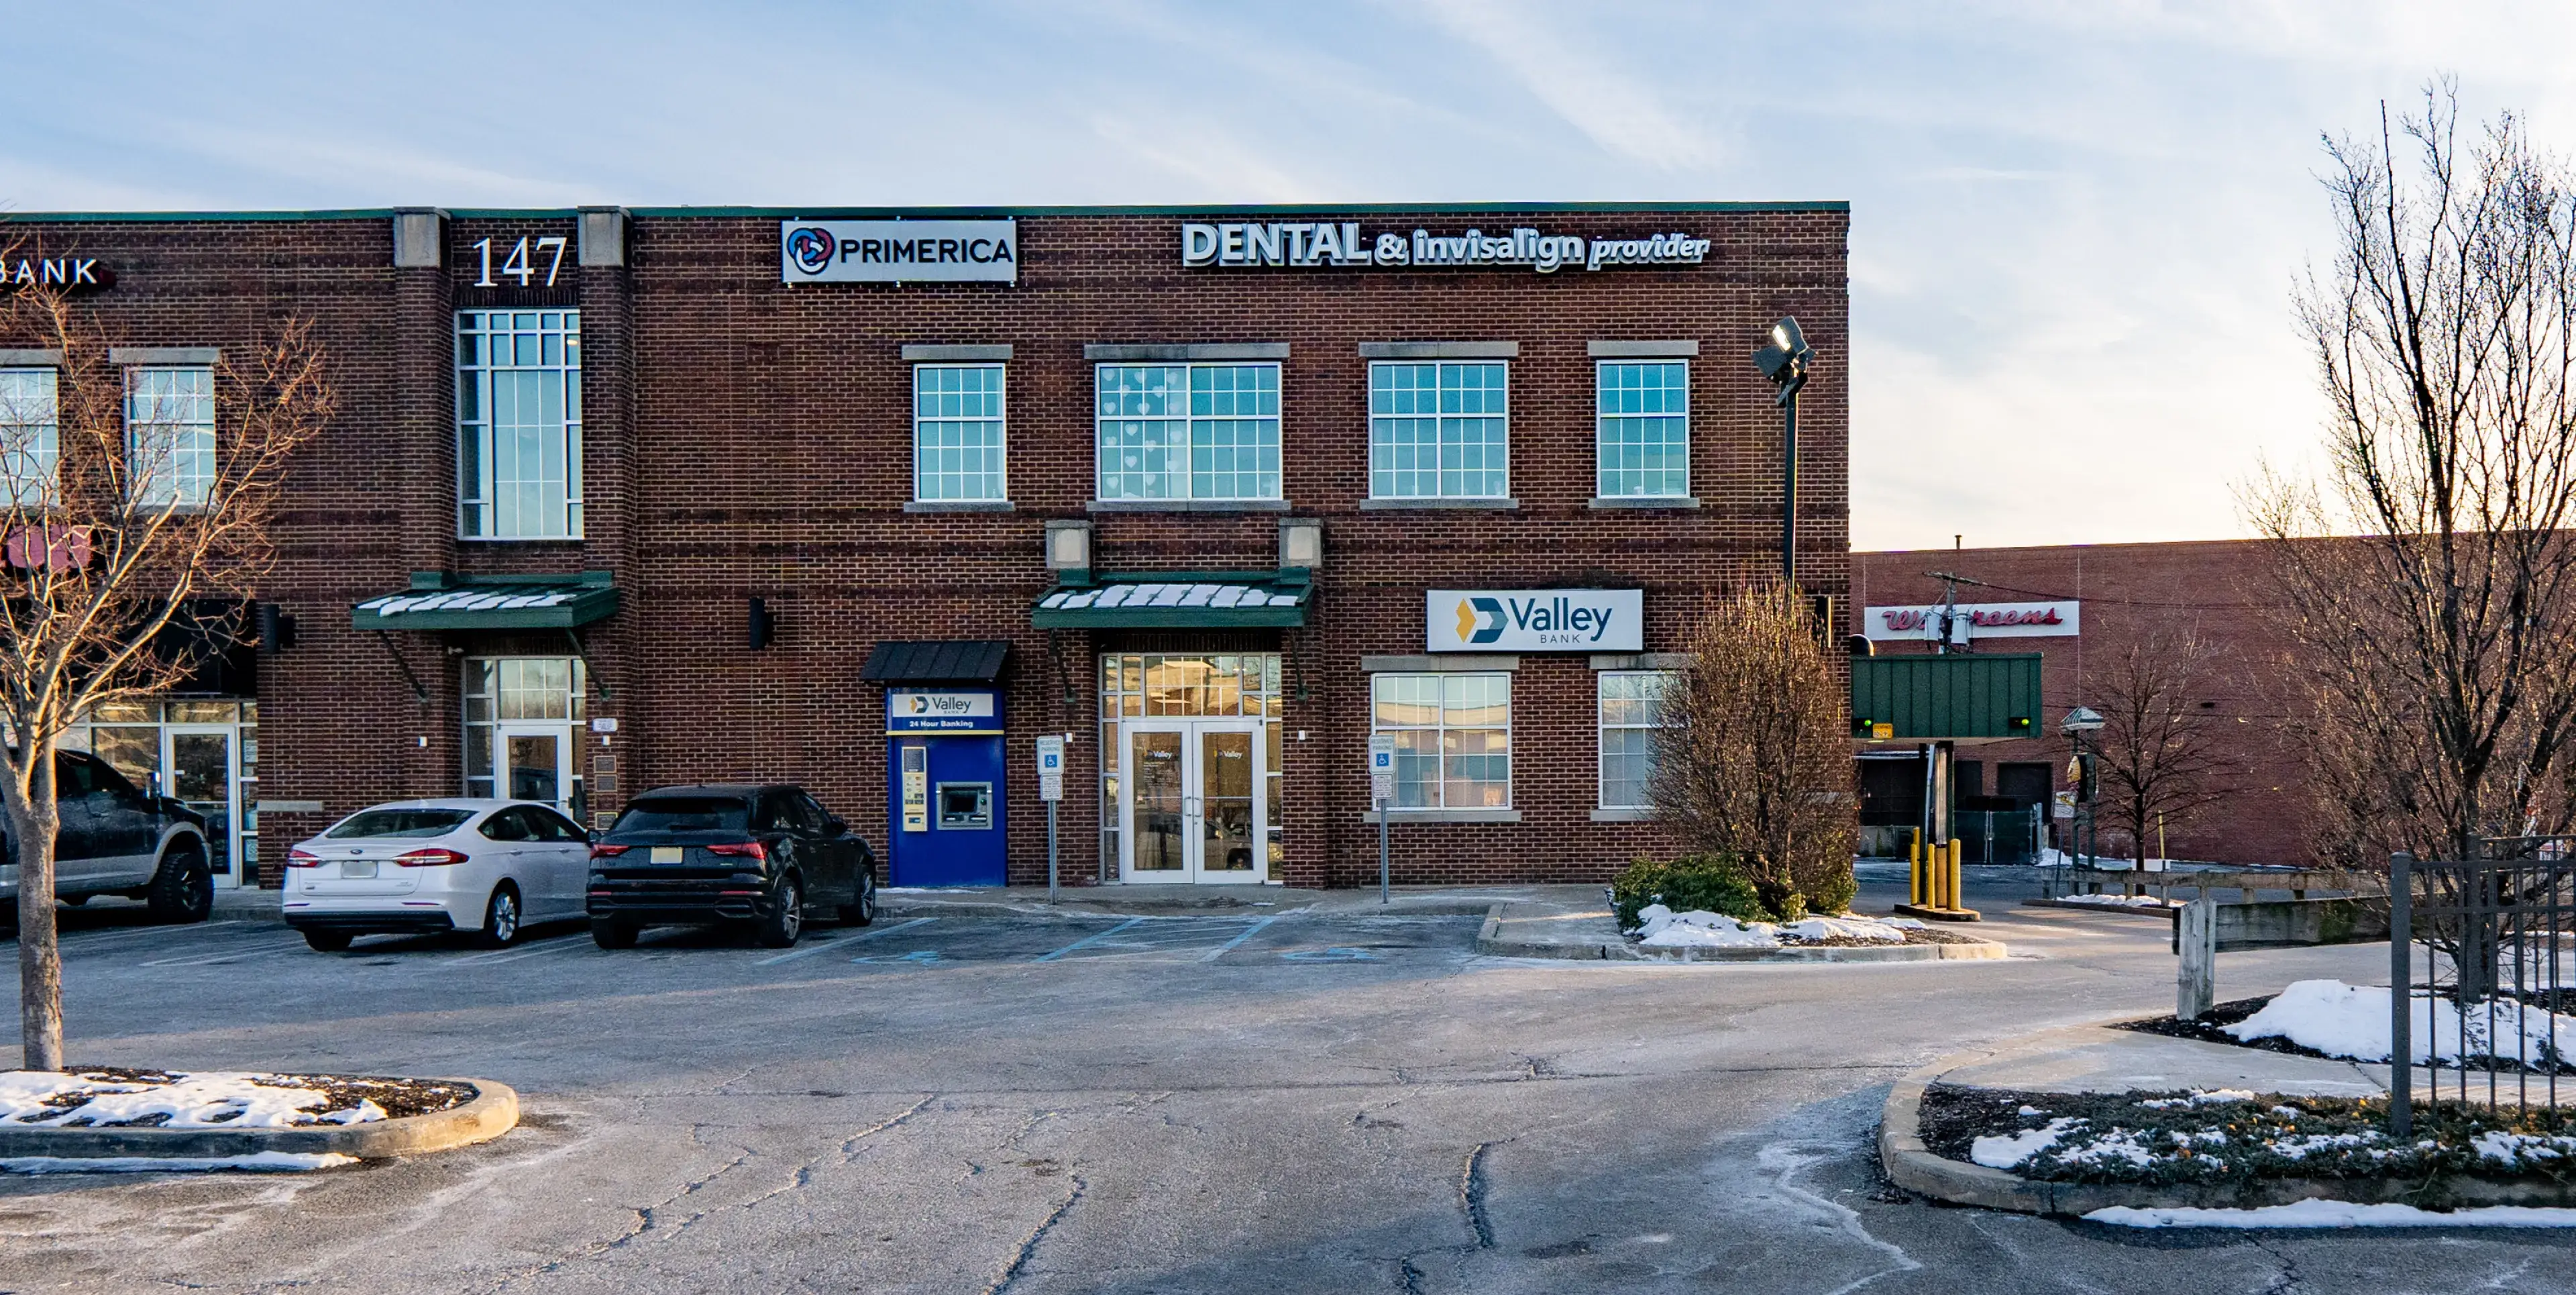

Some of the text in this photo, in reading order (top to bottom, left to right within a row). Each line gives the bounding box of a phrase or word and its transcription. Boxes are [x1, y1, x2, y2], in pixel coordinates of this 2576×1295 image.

[840, 238, 1014, 264] PRIMERICA
[1183, 223, 1710, 271] DENTAL & invisalign provider
[472, 236, 568, 287] 147
[1509, 597, 1613, 642] Valley
[1540, 633, 1581, 643] BANK
[931, 696, 972, 714] Valley
[941, 719, 974, 729] Banking
